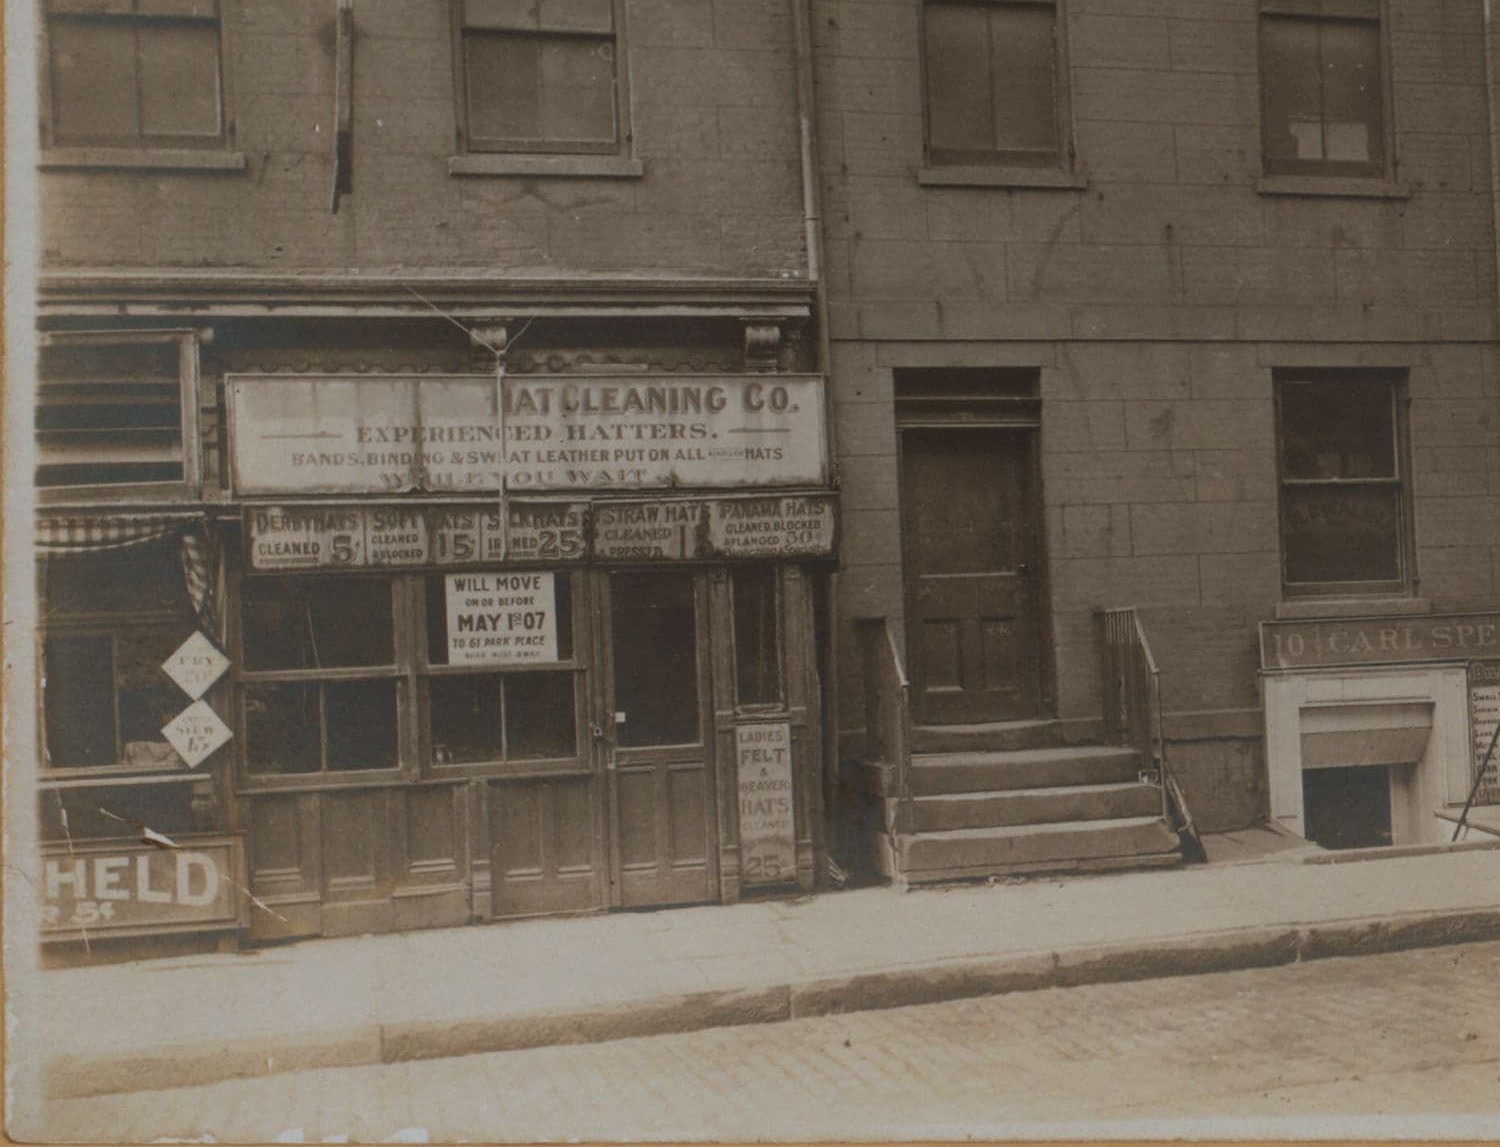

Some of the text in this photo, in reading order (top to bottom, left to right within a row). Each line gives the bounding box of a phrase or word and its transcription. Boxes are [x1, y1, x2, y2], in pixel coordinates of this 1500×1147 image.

[561, 386, 727, 415] CLEANING
[356, 423, 719, 444] EXPERIENCED HATTERS.
[464, 450, 530, 464] SWAT
[537, 449, 609, 463] LEATHER
[614, 448, 643, 461] PUT
[649, 448, 670, 461] ON
[675, 448, 705, 461] ALL
[745, 447, 783, 460] HATS
[379, 471, 483, 485] WILE
[567, 469, 648, 484] WAIT
[786, 500, 825, 516] HATS
[486, 512, 533, 531] SLK
[371, 534, 419, 545] CLEANED
[488, 537, 538, 551] IRNED
[258, 542, 321, 556] CLEANED
[454, 576, 542, 592] WILL MOVE
[465, 596, 535, 607] ON OR BEFORE
[458, 612, 545, 632] MAY 07
[452, 637, 466, 649] TO
[484, 636, 511, 647] PARK
[515, 635, 545, 646] PLACE
[1272, 633, 1305, 656] 10
[1328, 628, 1423, 653] CARL
[1473, 692, 1497, 701] SMALL
[740, 731, 784, 743] LADIES
[742, 748, 785, 764] FELT
[742, 797, 790, 815] HATS
